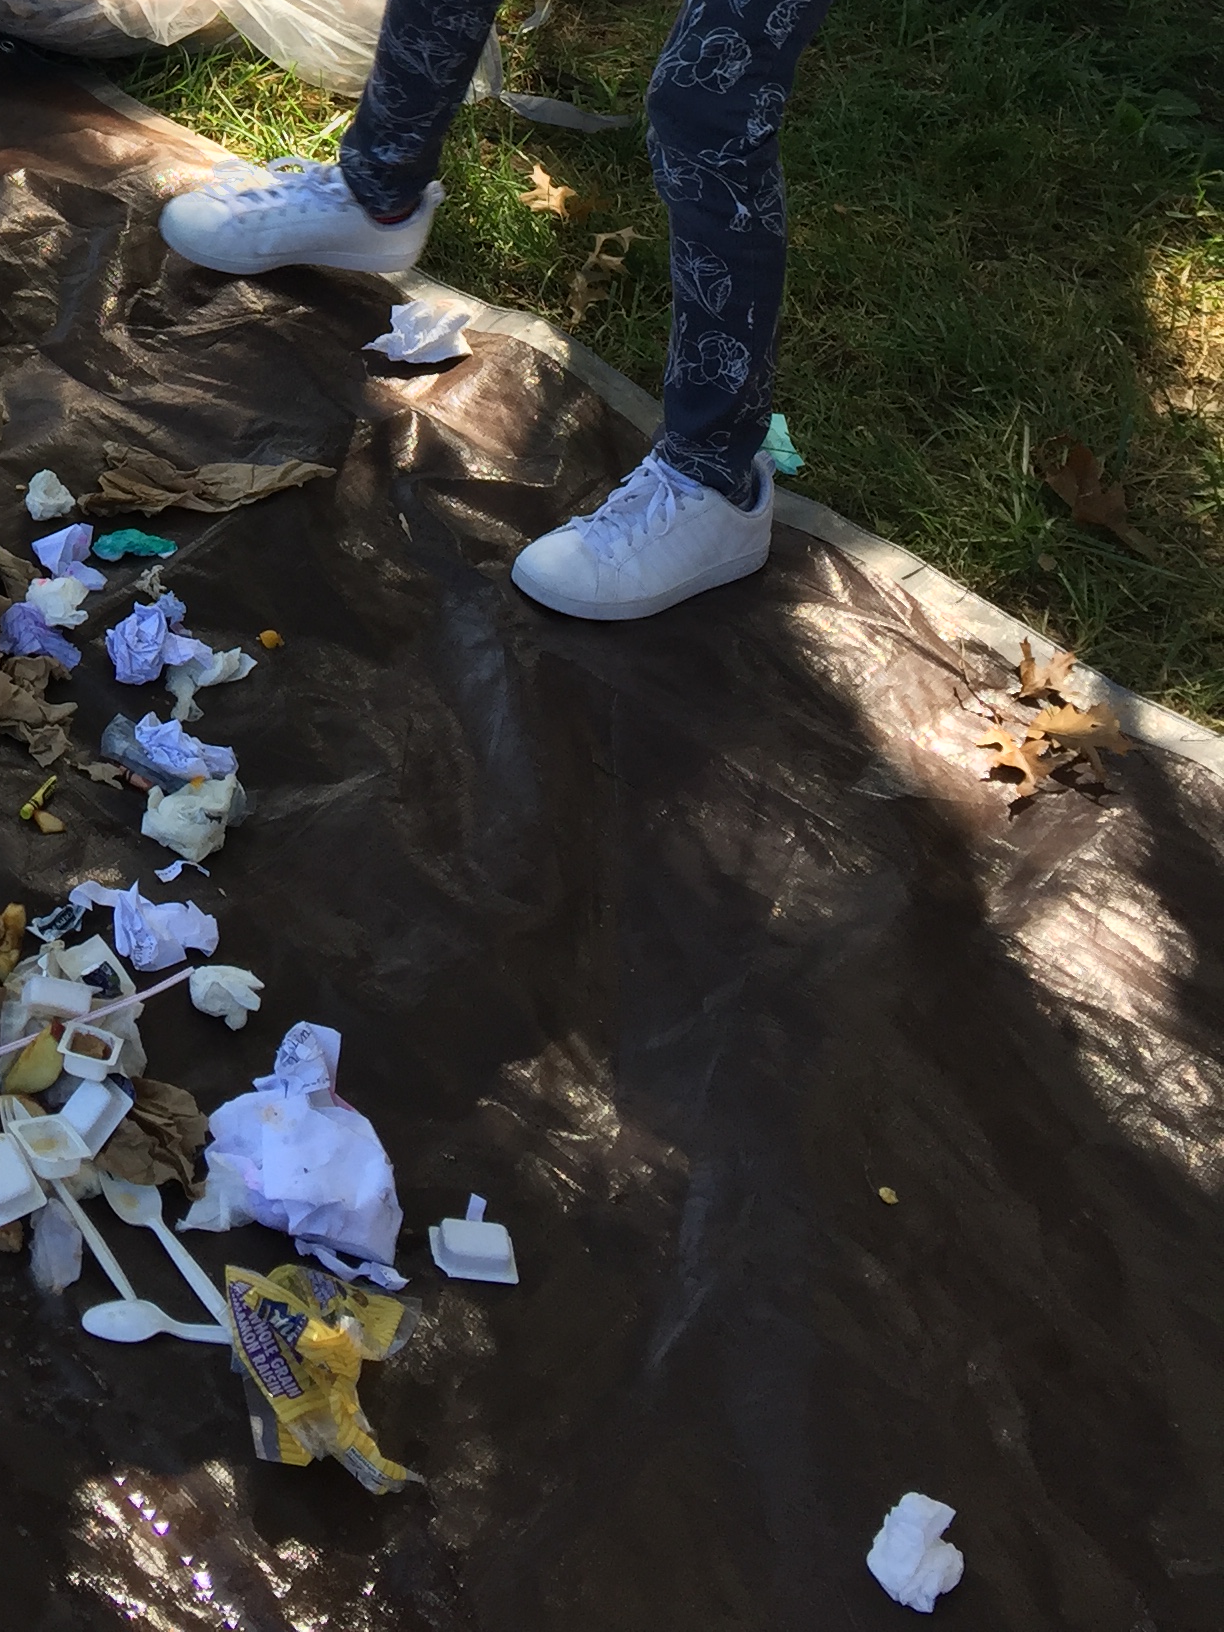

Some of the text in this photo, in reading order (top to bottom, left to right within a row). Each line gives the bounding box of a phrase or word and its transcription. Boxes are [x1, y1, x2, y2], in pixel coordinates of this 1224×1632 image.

[248, 1311, 279, 1357] WHOLE
[270, 1357, 302, 1398] GRAIN
[251, 1353, 284, 1396] RAISIN
